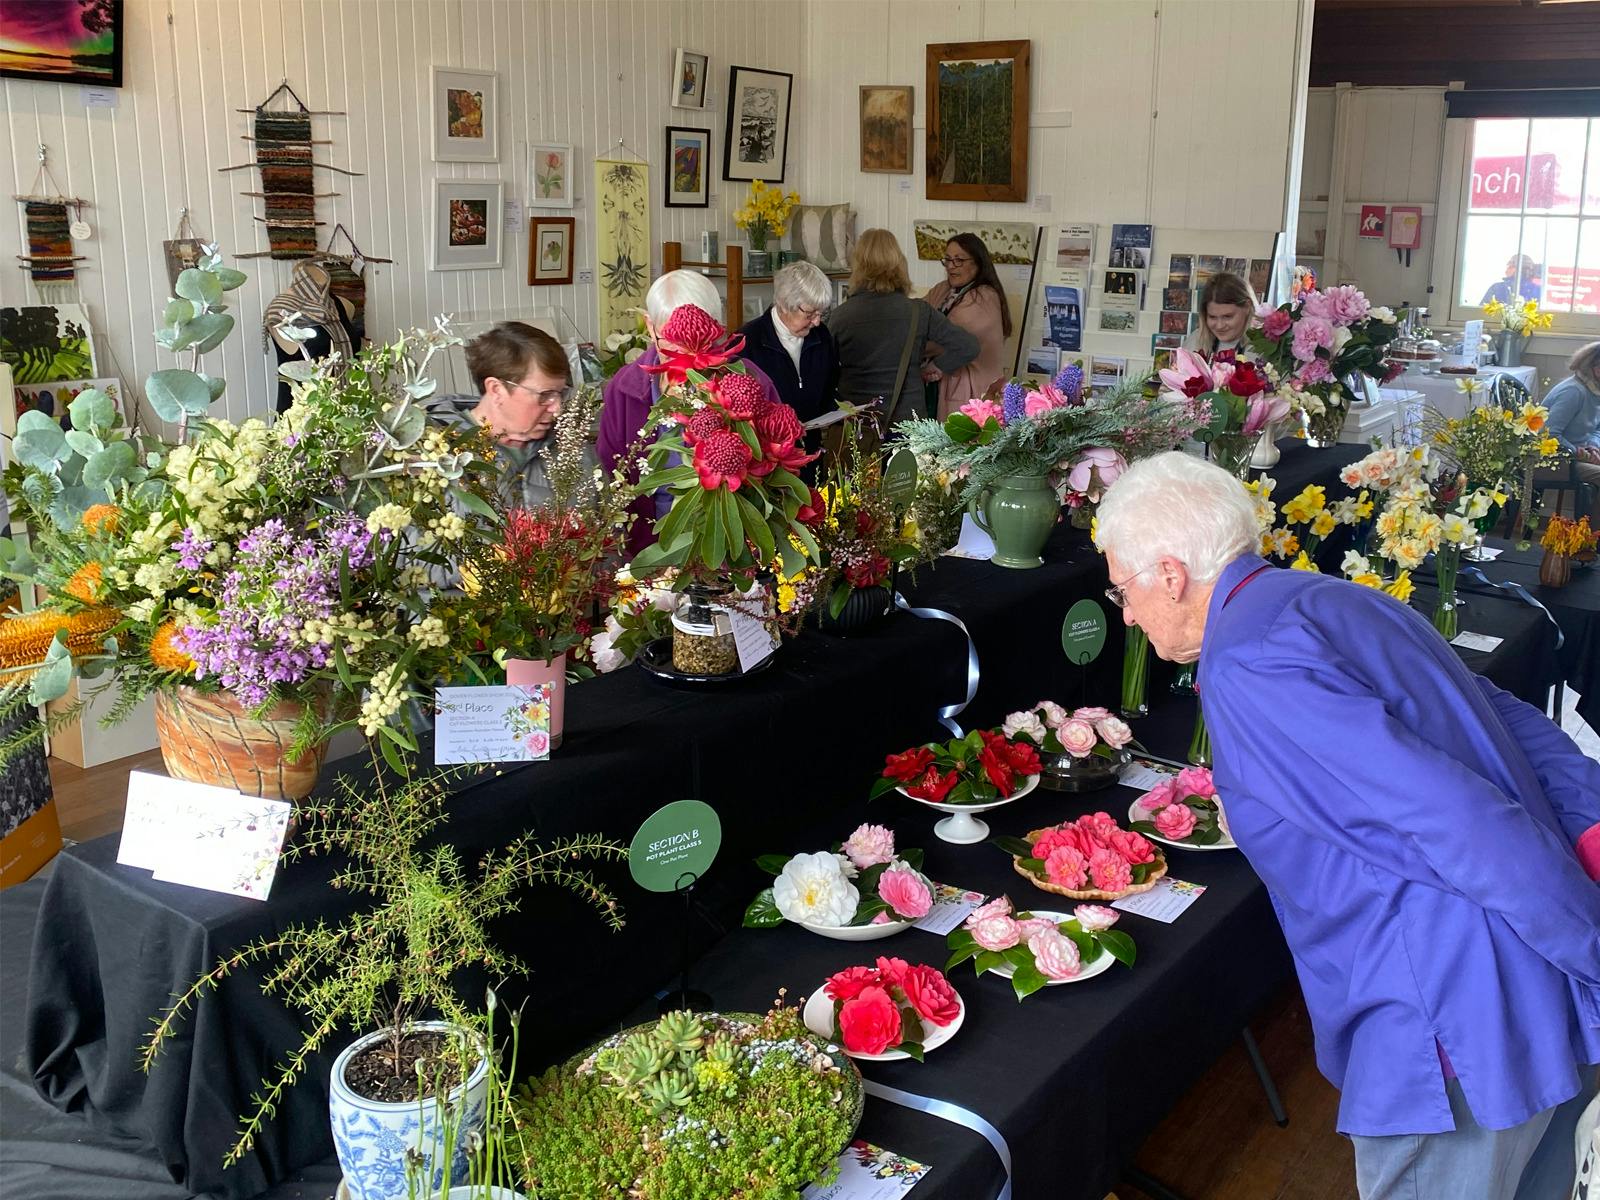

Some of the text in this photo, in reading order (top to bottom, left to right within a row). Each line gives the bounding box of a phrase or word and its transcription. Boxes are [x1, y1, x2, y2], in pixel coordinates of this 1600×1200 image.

[465, 702, 494, 713] Place
[649, 829, 699, 852] SECTION B
[646, 853, 659, 861] POT
[659, 847, 678, 857] PLANT
[679, 842, 697, 850] CLASS
